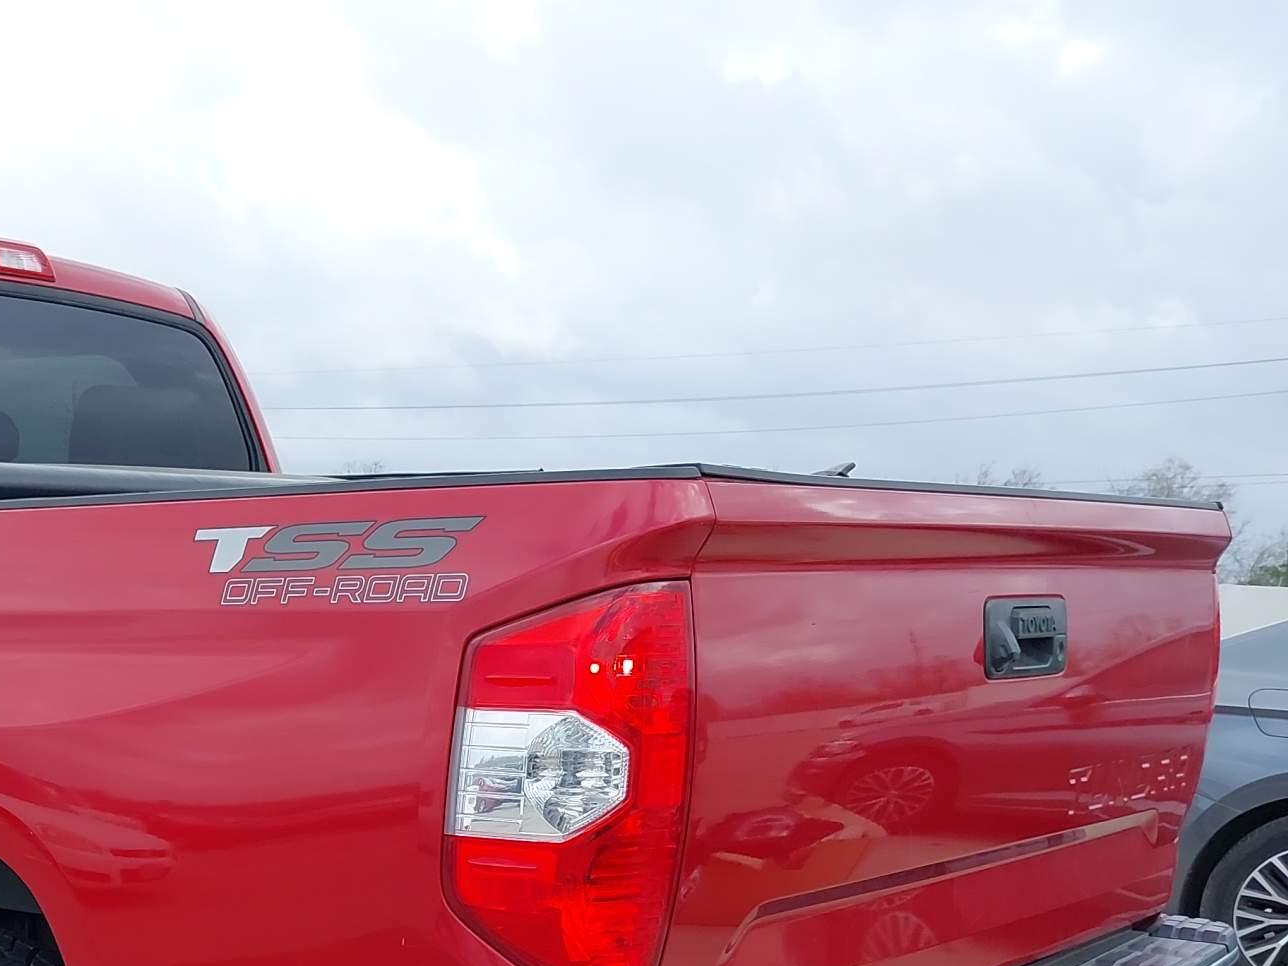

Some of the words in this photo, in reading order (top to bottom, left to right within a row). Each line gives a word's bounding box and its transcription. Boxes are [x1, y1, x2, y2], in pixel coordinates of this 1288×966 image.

[193, 515, 487, 574] TSS
[220, 572, 472, 605] OFF-ROAD
[1017, 615, 1057, 635] TOYOTA
